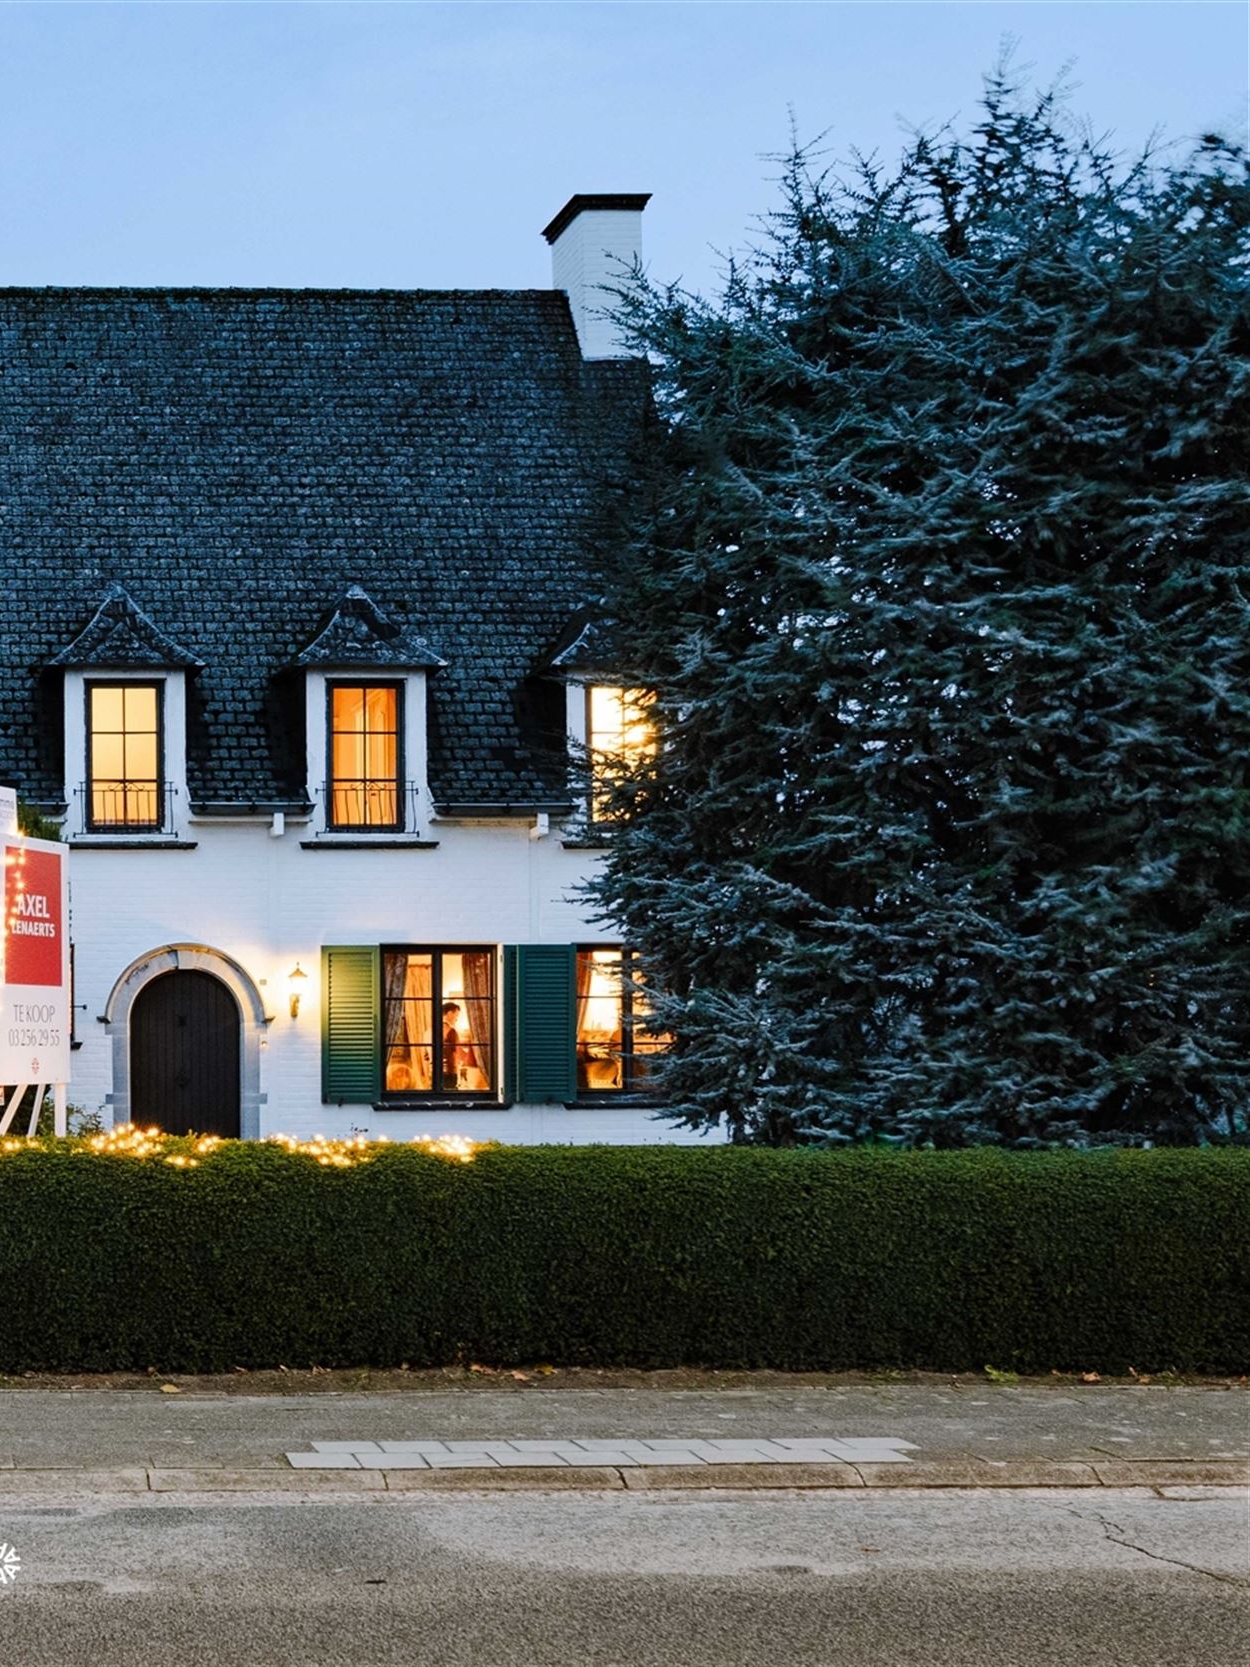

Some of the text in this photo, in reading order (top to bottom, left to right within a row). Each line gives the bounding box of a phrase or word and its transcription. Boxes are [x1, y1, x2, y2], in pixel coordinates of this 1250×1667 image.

[17, 894, 50, 918] AXEL
[12, 920, 55, 937] LENAERTS
[13, 1004, 56, 1023] TE KOOP
[8, 1029, 60, 1047] 03 256 29 55
